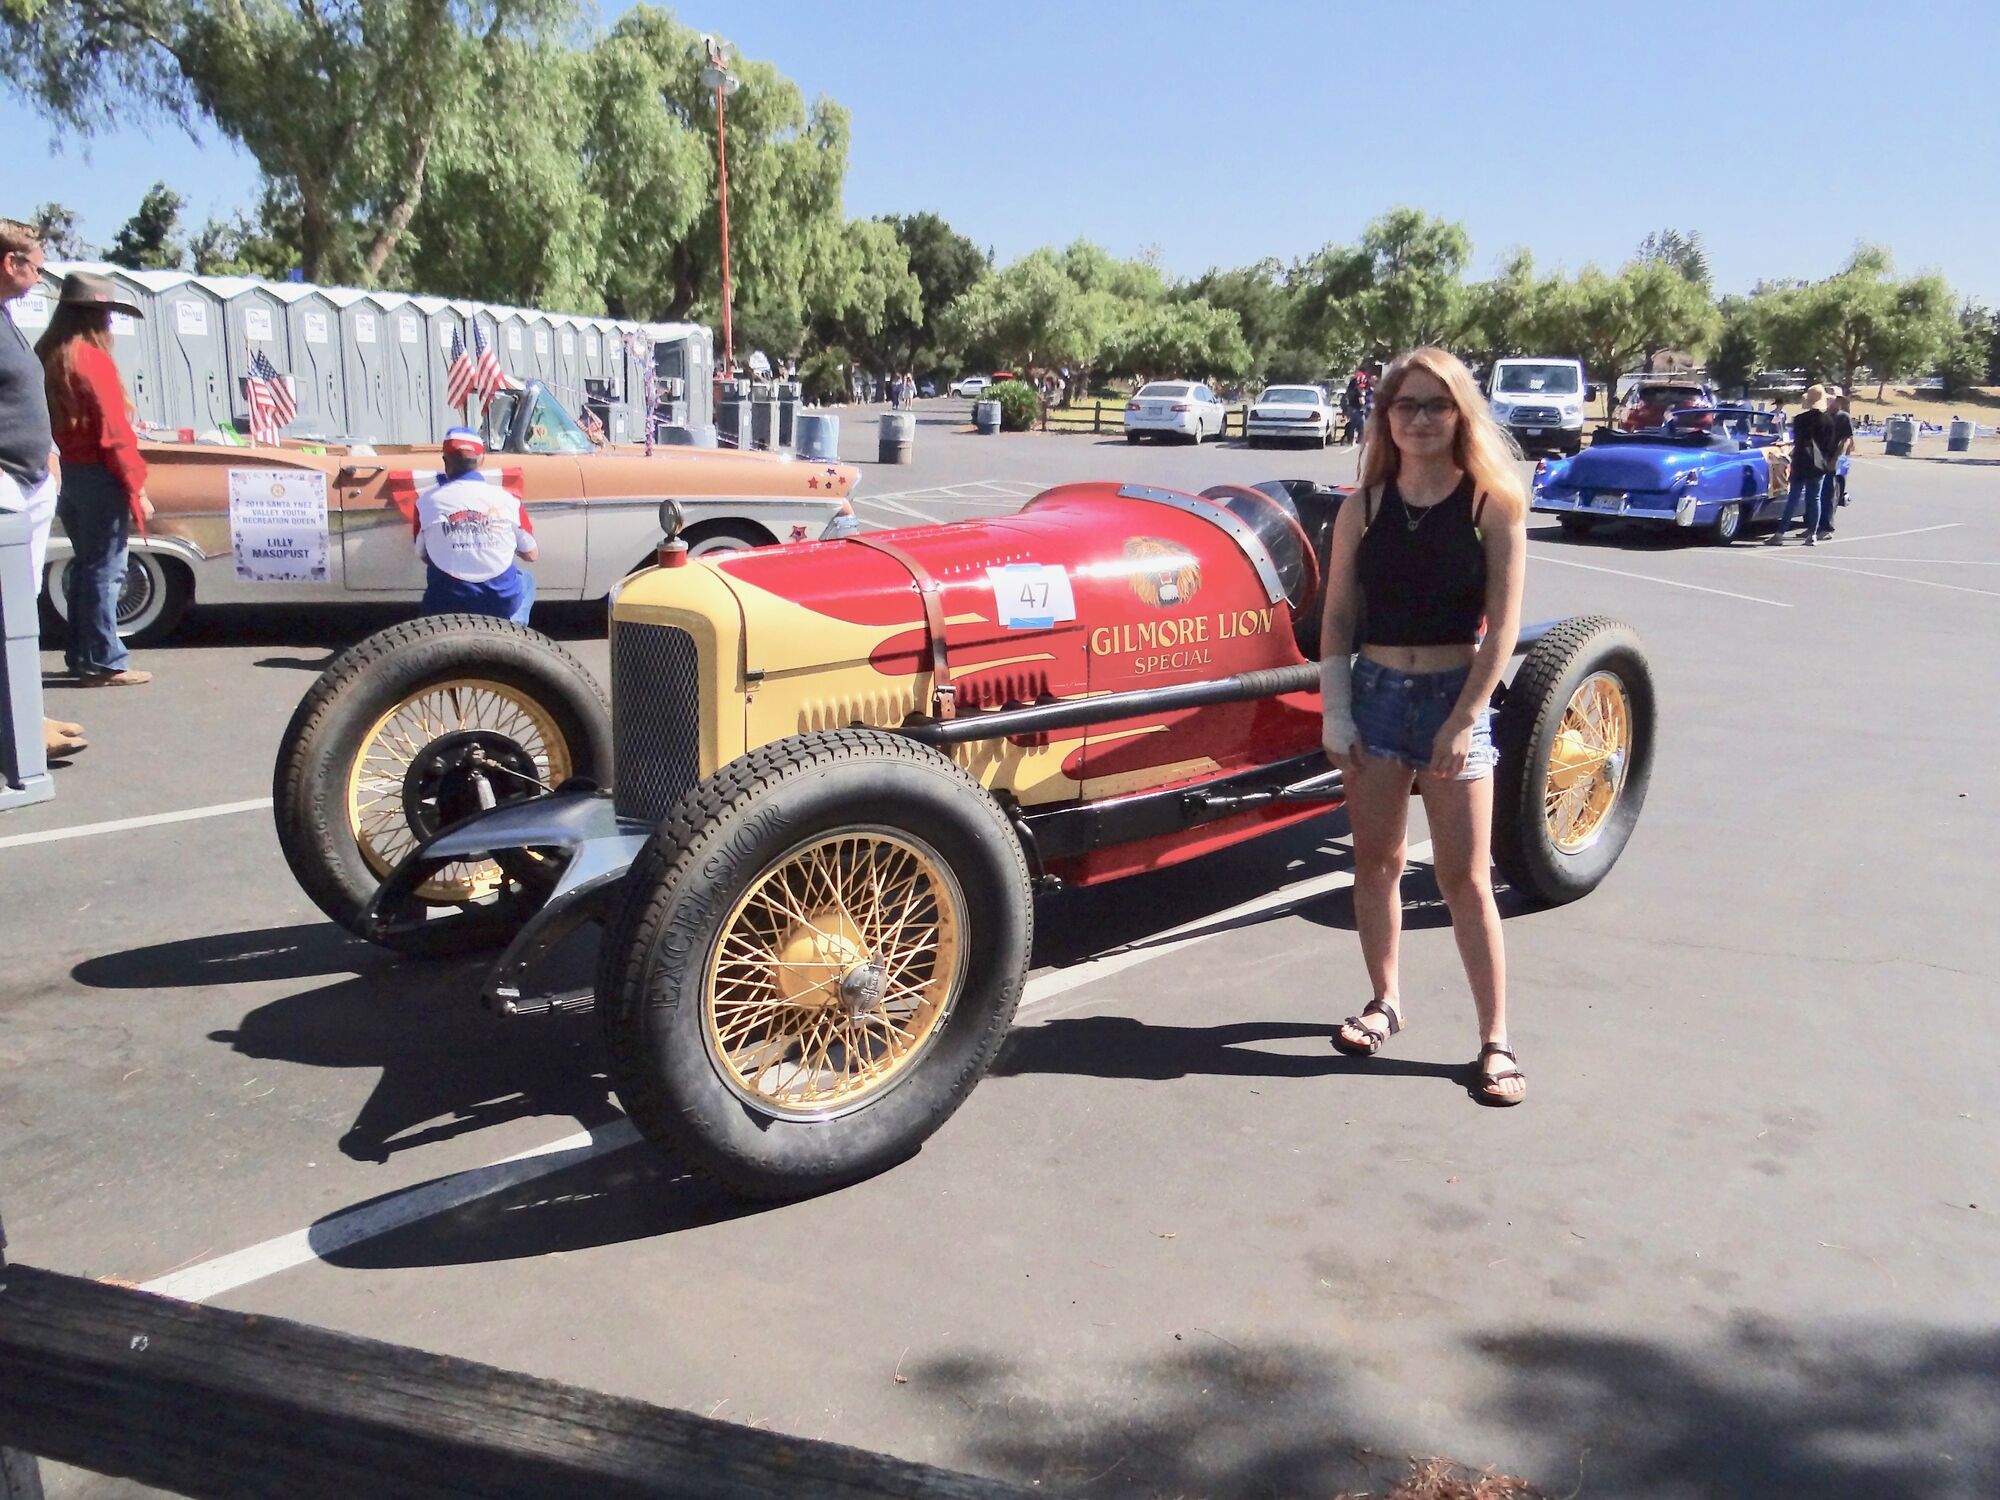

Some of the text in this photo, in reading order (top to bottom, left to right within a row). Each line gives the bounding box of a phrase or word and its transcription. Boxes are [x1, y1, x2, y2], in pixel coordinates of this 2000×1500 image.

[291, 517, 316, 525] QUEEN
[252, 549, 309, 558] MASOPUST
[267, 537, 293, 547] LILLY
[1019, 582, 1050, 609] 47
[1091, 607, 1275, 656] GILMORE LION
[1134, 648, 1212, 675] SPECIAL
[652, 803, 790, 1009] EXCELSIOR
